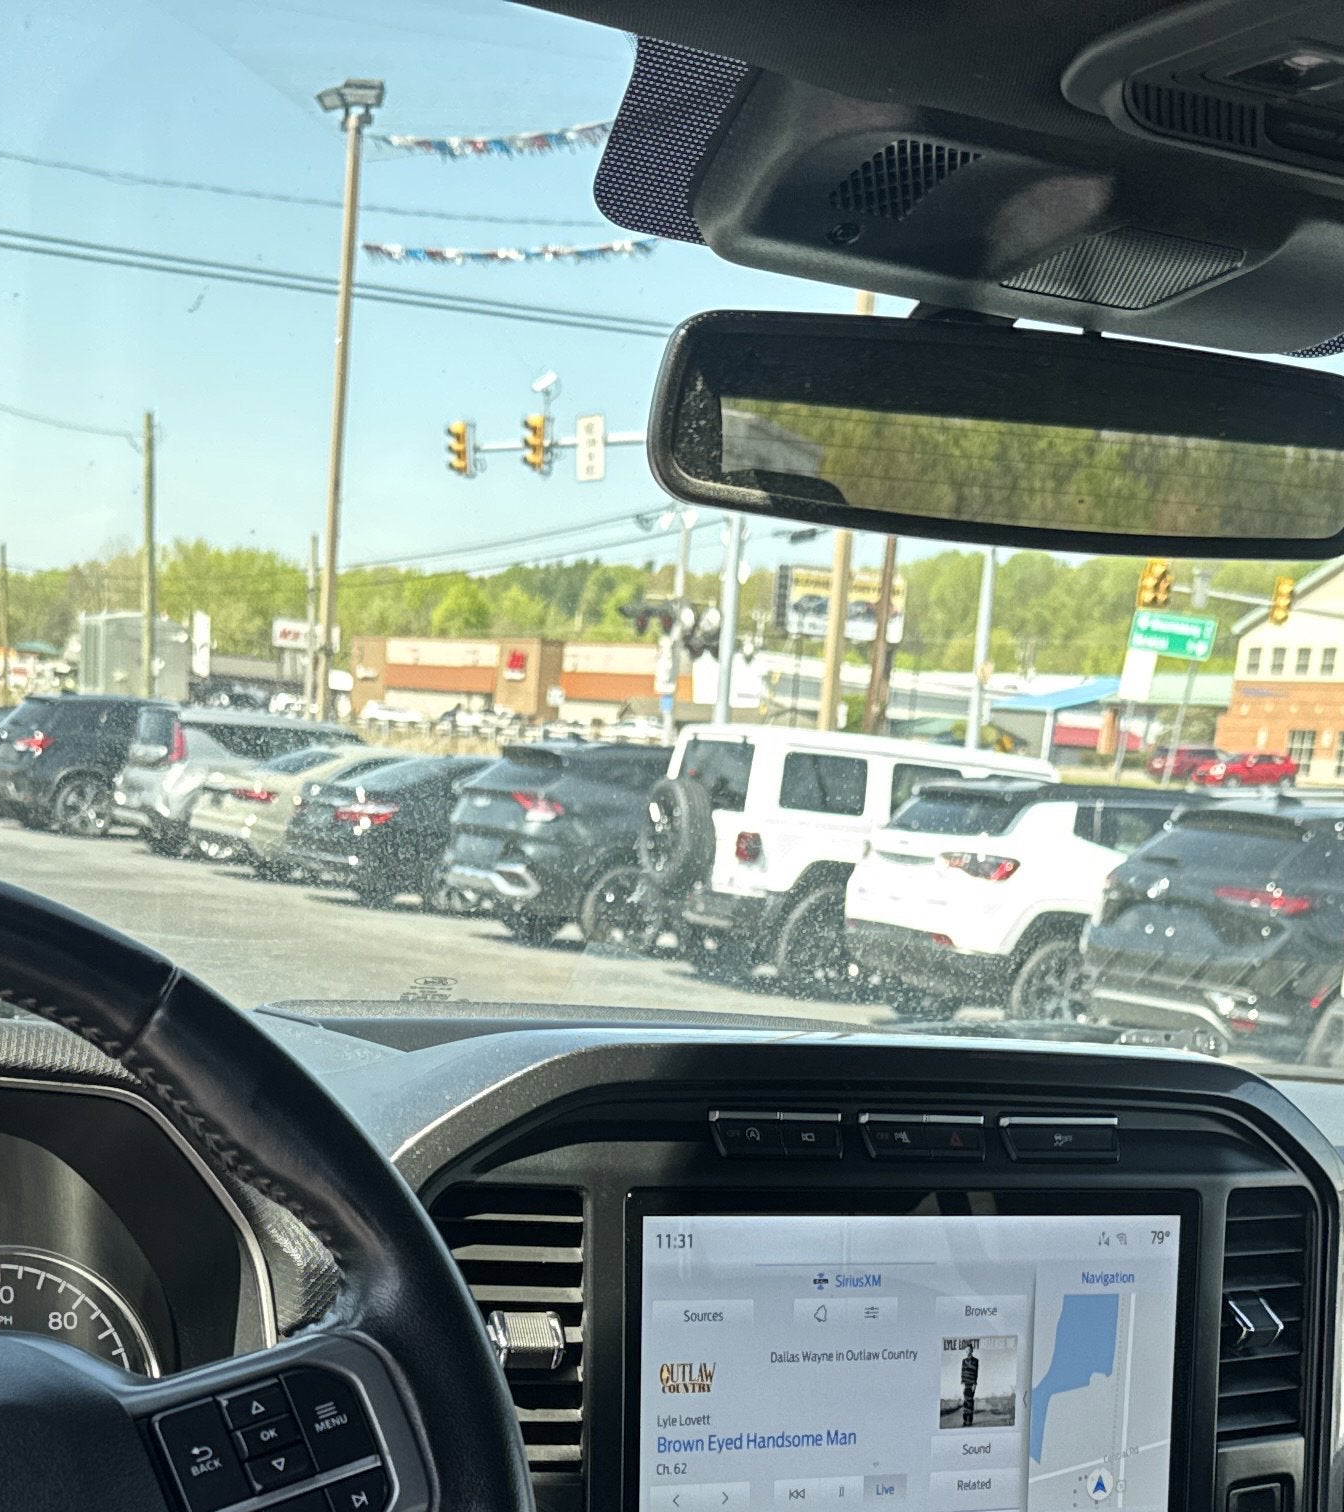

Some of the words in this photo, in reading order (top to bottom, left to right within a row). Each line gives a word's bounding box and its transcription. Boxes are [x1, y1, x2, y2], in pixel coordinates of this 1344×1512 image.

[656, 1233, 693, 1249] 11:31
[835, 1274, 882, 1289] SiriusXM
[1081, 1271, 1135, 1287] Navigation
[683, 1310, 724, 1322] Sources
[965, 1305, 998, 1317] Browse
[48, 1311, 78, 1330] 80
[770, 1351, 800, 1364] Dallas
[802, 1350, 834, 1365] Wayne
[836, 1349, 845, 1361] in
[846, 1348, 879, 1361] Outlaw
[882, 1347, 918, 1362] Country
[659, 1362, 716, 1386] OUTLAW
[661, 1382, 712, 1394] COUNTRY
[314, 1414, 348, 1433] MENU
[657, 1415, 678, 1429] Lyle
[679, 1414, 711, 1427] Lovett
[260, 1427, 278, 1441] OK
[657, 1436, 705, 1454] Brown
[708, 1432, 744, 1454] Eyed
[746, 1430, 823, 1450] Handsome
[827, 1429, 857, 1446] Man
[962, 1442, 992, 1456] Sound
[190, 1458, 223, 1478] BACK
[656, 1463, 672, 1475] Ch.
[673, 1462, 688, 1475] 62
[876, 1484, 895, 1496] Live
[957, 1478, 992, 1491] Related
